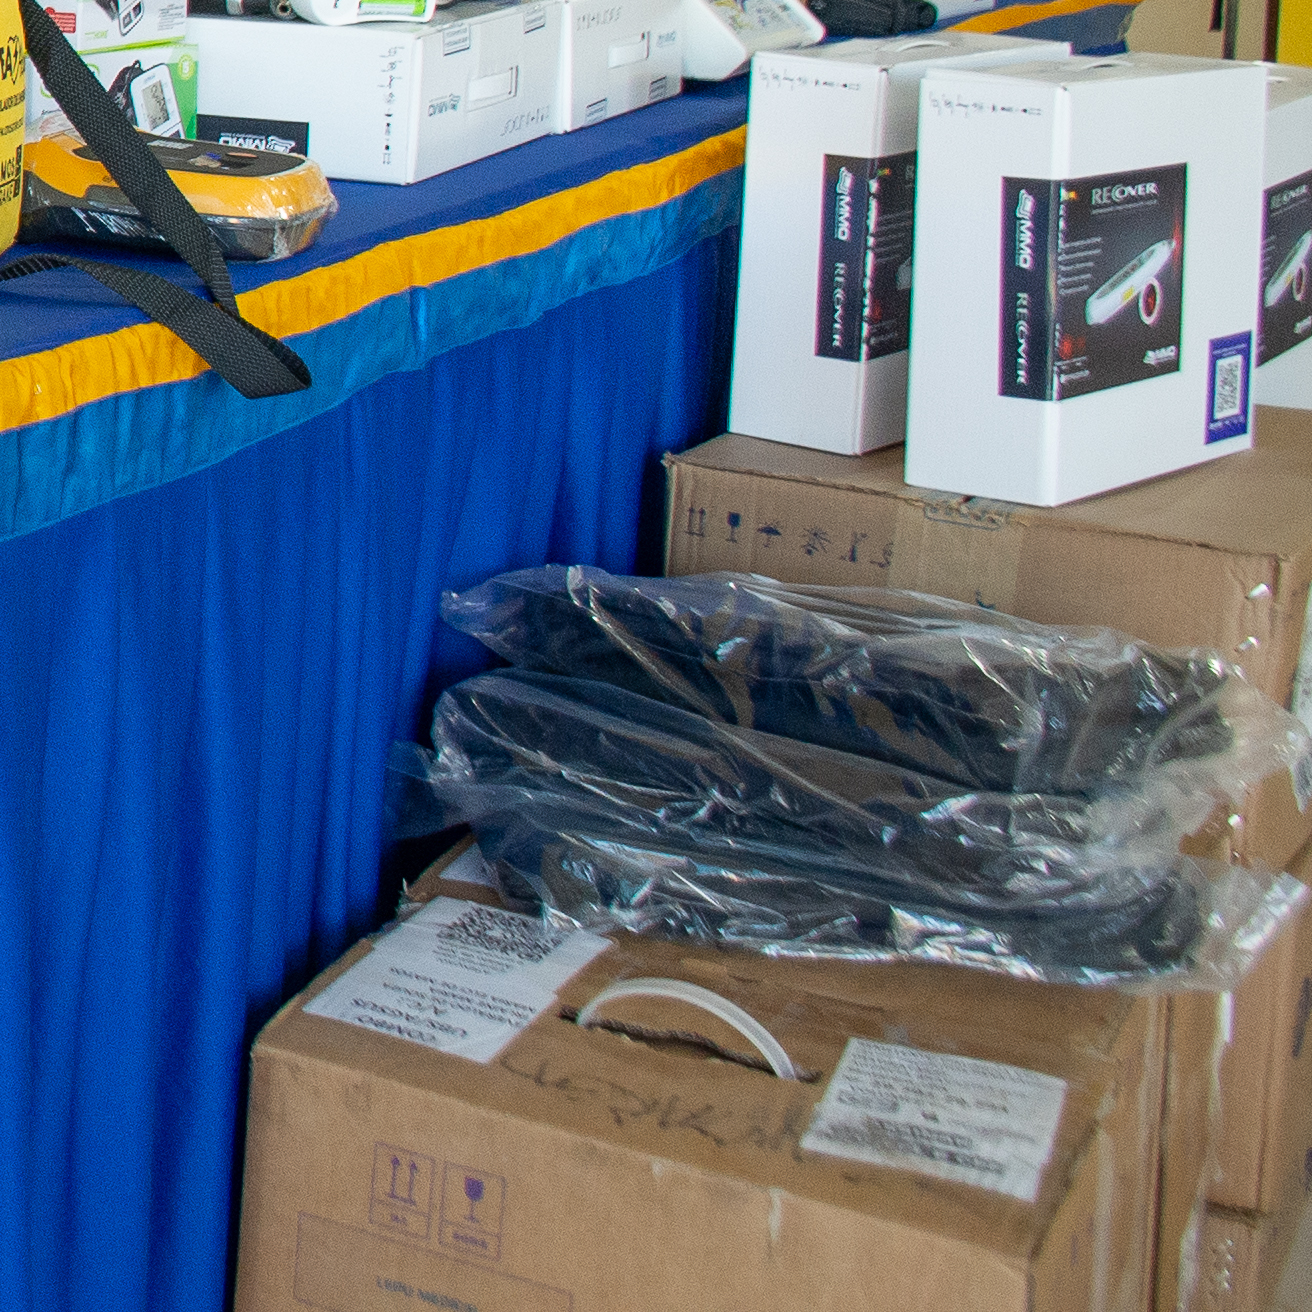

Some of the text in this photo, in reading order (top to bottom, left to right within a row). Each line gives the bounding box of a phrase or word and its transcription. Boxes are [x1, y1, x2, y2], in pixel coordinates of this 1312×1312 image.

[1091, 181, 1159, 206] RECOVER
[832, 262, 848, 349] RECOVER
[1015, 291, 1030, 387] RECOVER
